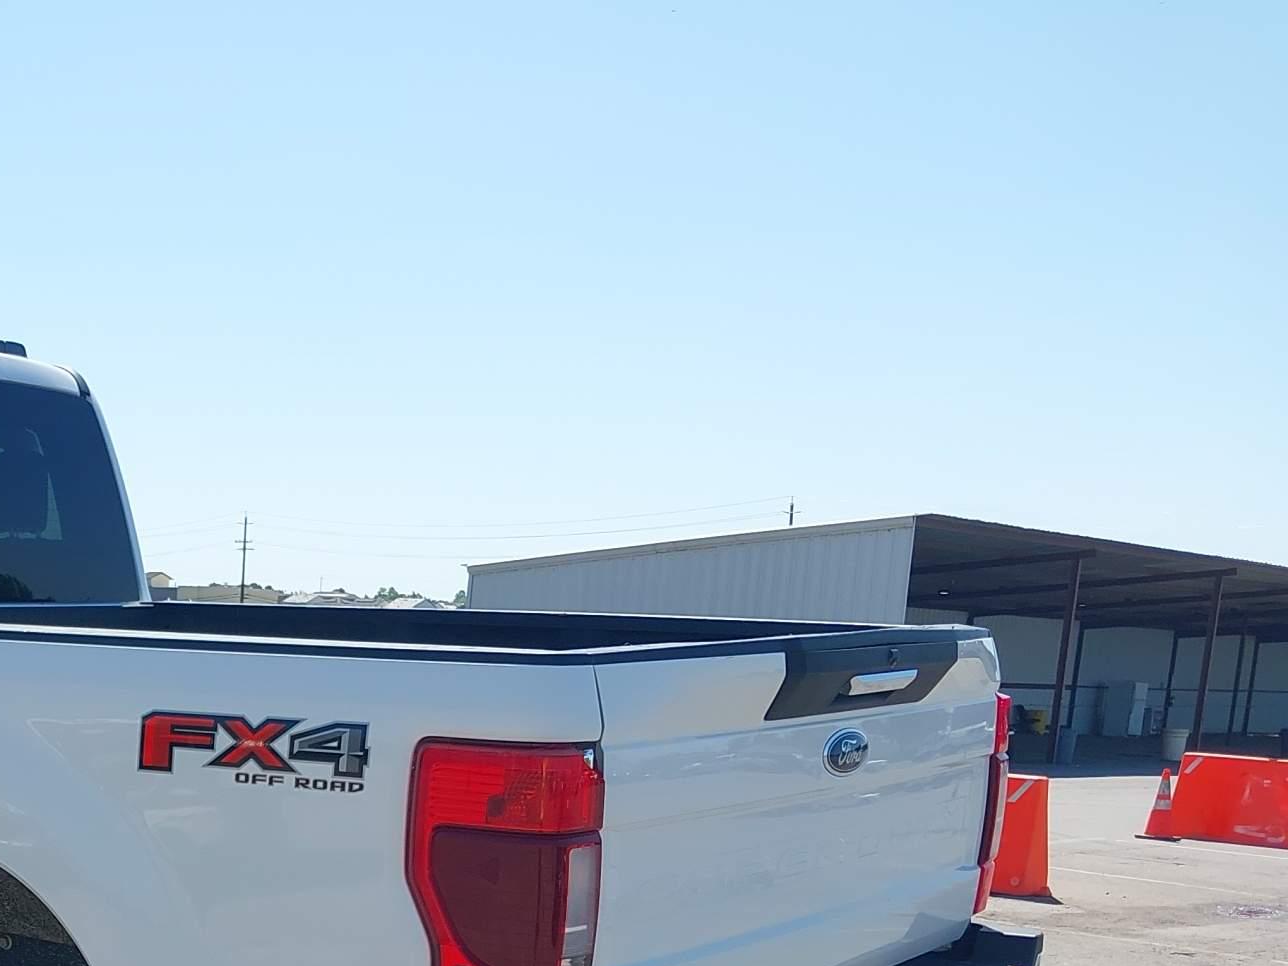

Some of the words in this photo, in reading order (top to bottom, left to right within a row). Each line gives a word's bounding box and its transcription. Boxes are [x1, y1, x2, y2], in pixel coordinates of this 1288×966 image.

[138, 708, 371, 778] FX4
[838, 739, 862, 766] Ford
[235, 772, 284, 787] OFF
[294, 777, 365, 793] ROAD
